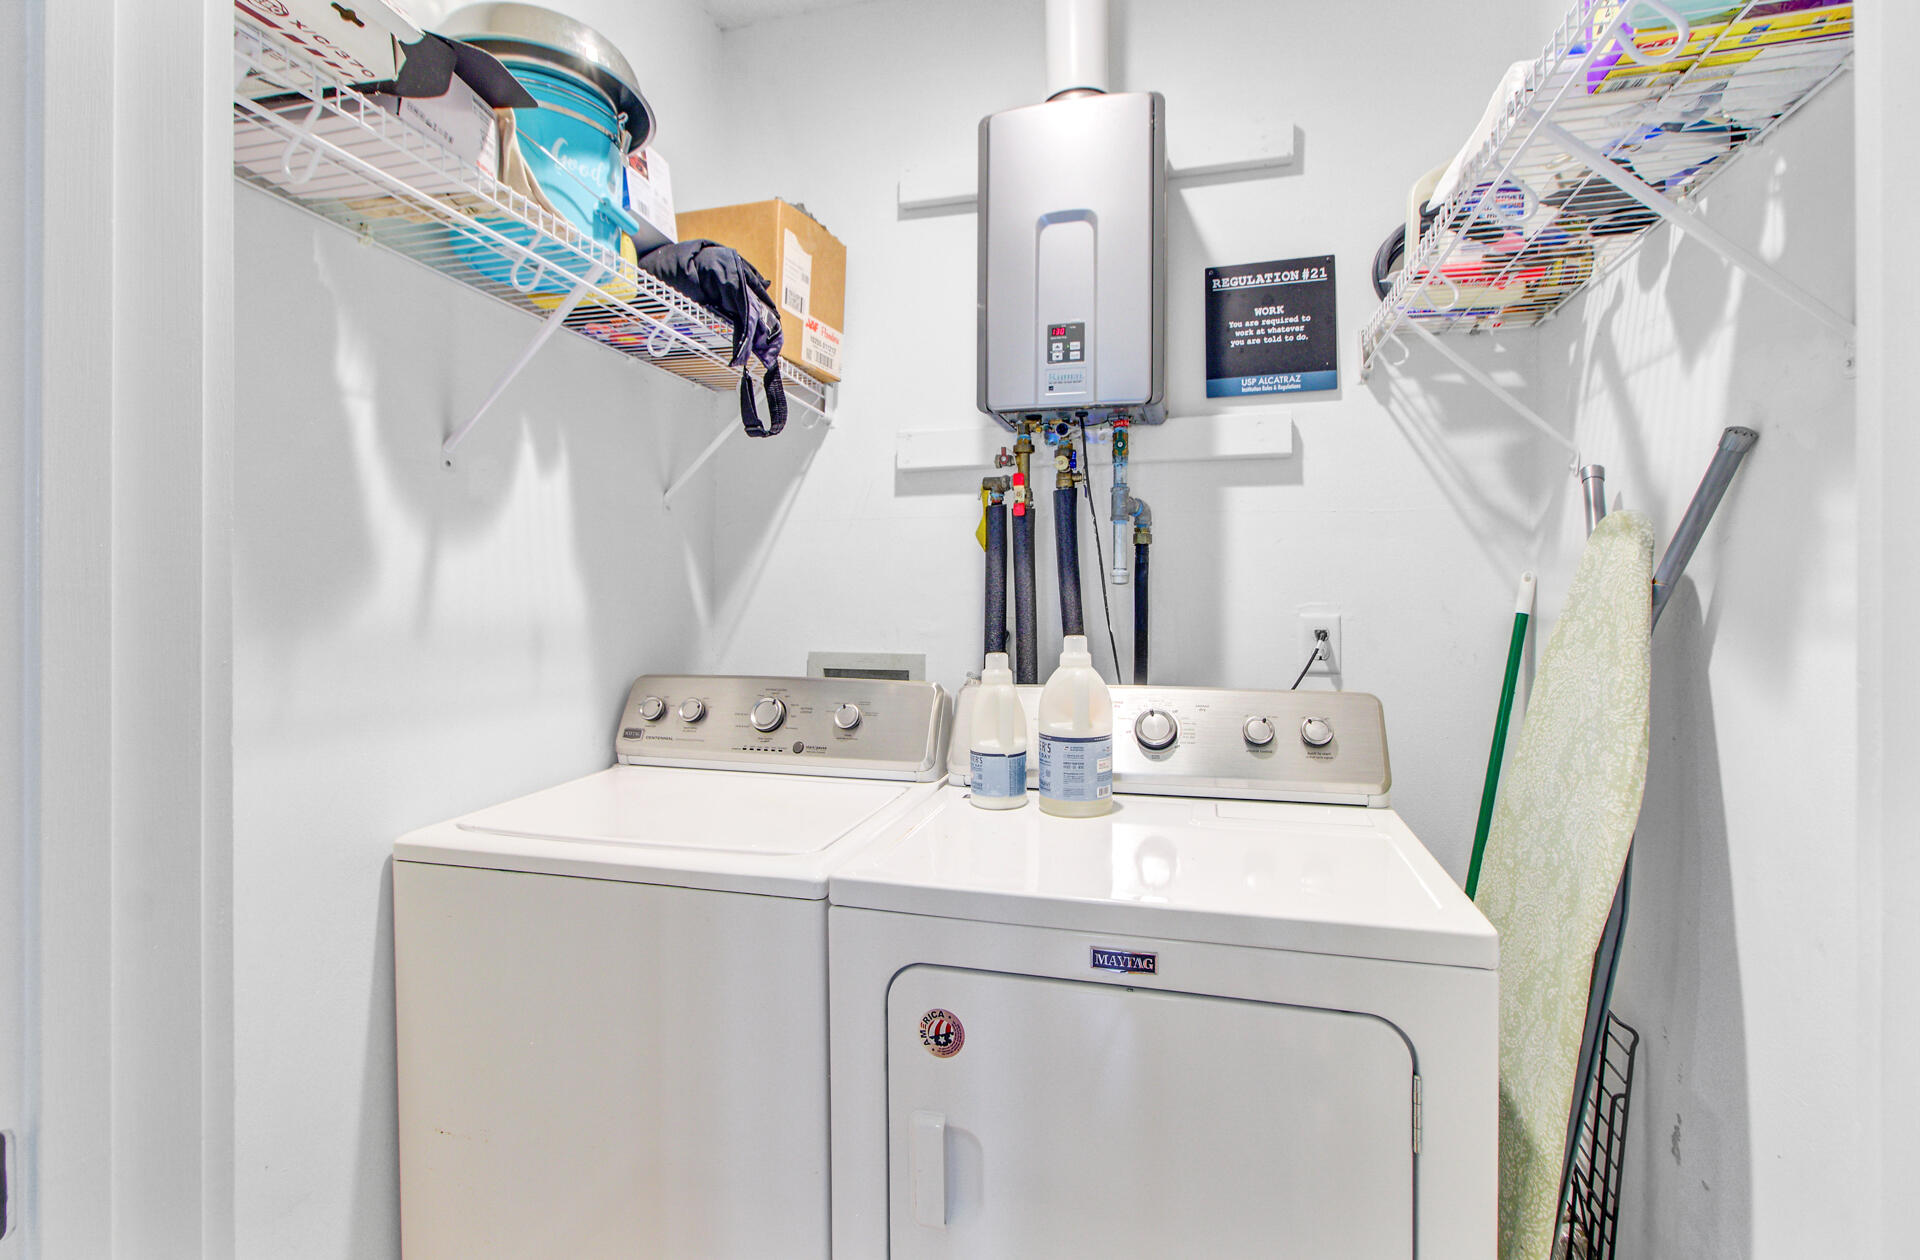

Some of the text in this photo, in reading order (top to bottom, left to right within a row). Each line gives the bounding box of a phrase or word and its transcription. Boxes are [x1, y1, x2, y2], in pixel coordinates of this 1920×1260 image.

[1212, 267, 1327, 288] REGULATION #21
[1254, 305, 1284, 317] WORK
[1228, 321, 1242, 329] You
[1261, 315, 1299, 328] required
[1235, 325, 1304, 337] work at whatever
[1230, 339, 1244, 348] you
[1263, 334, 1282, 344] told
[1284, 334, 1294, 342] to
[1296, 333, 1309, 342] do.
[1241, 374, 1301, 387] USP ALCATRAZ
[1094, 952, 1154, 970] MAYTAG
[919, 1010, 945, 1046] AMERICA
